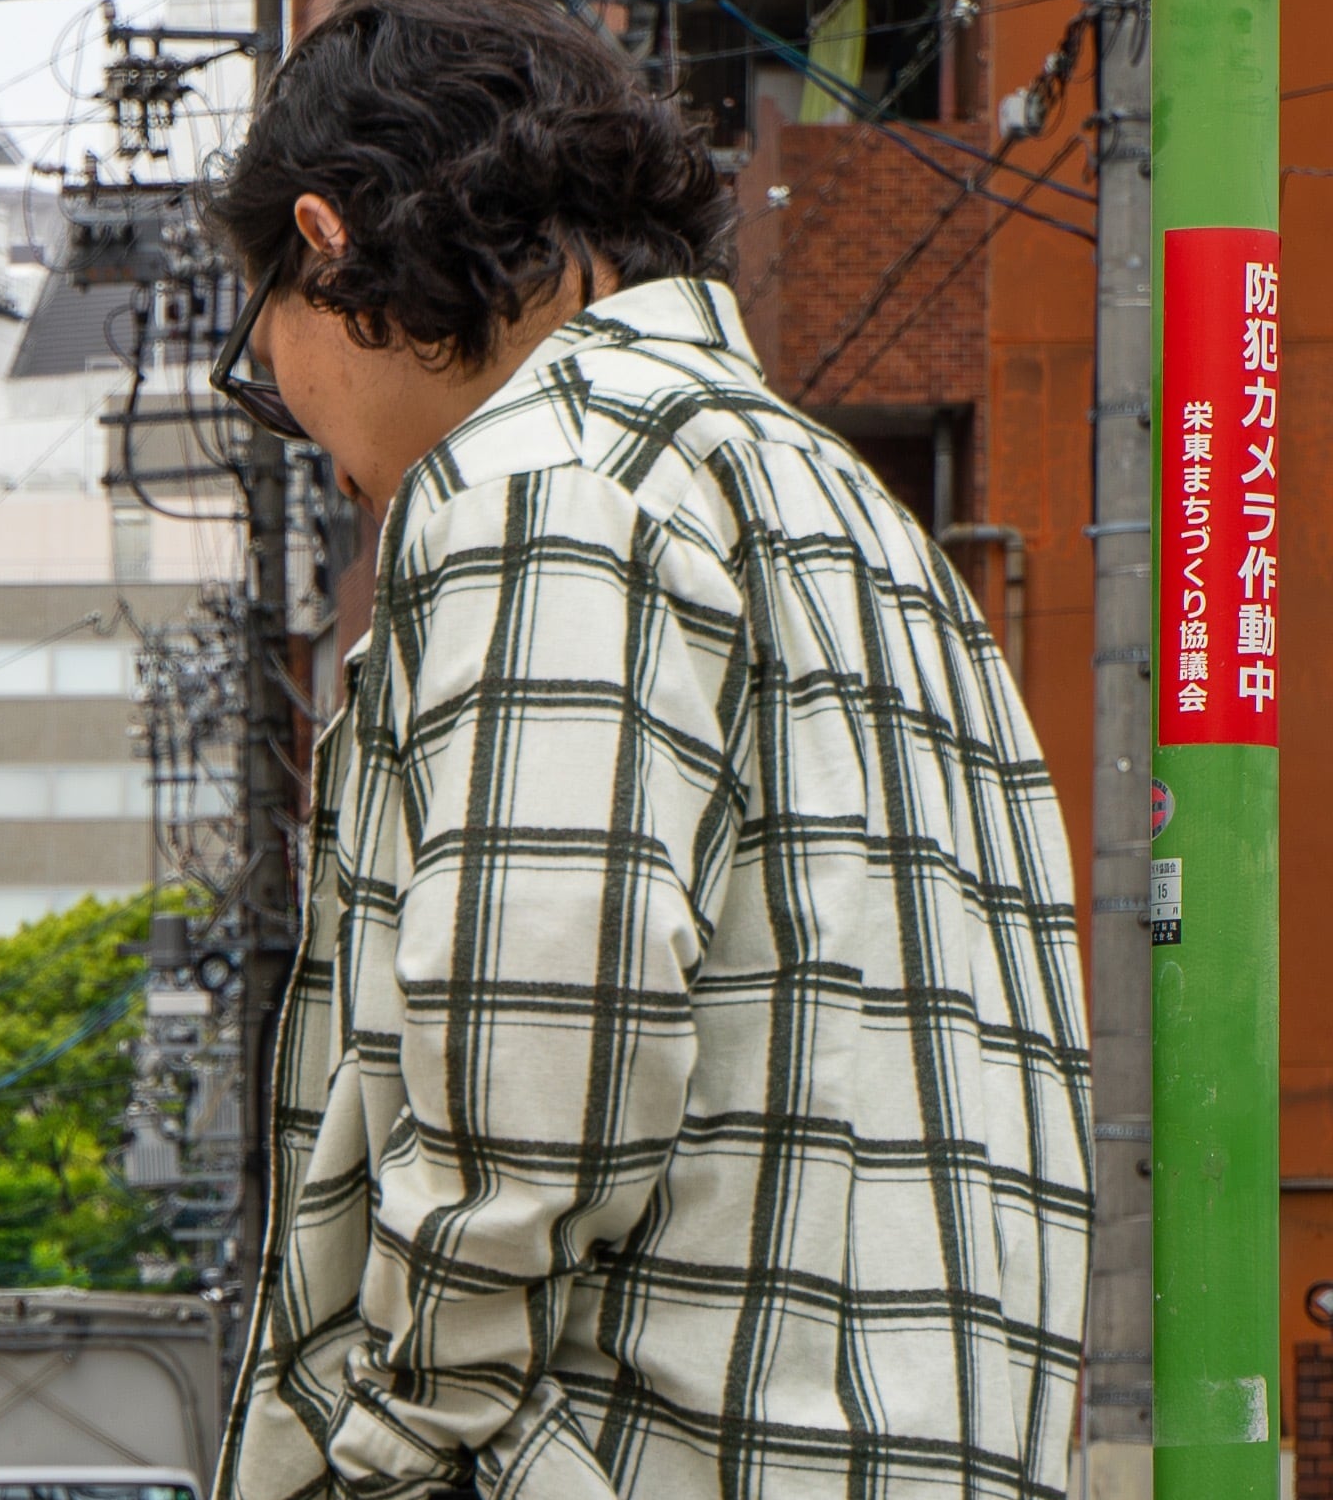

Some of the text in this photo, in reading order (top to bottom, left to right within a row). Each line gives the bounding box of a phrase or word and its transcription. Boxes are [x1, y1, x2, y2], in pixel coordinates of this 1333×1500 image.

[1177, 401, 1214, 714] 栄東まちづくり協議会
[1237, 261, 1279, 714] 防犯カメラ作動中
[1157, 883, 1169, 899] 15
